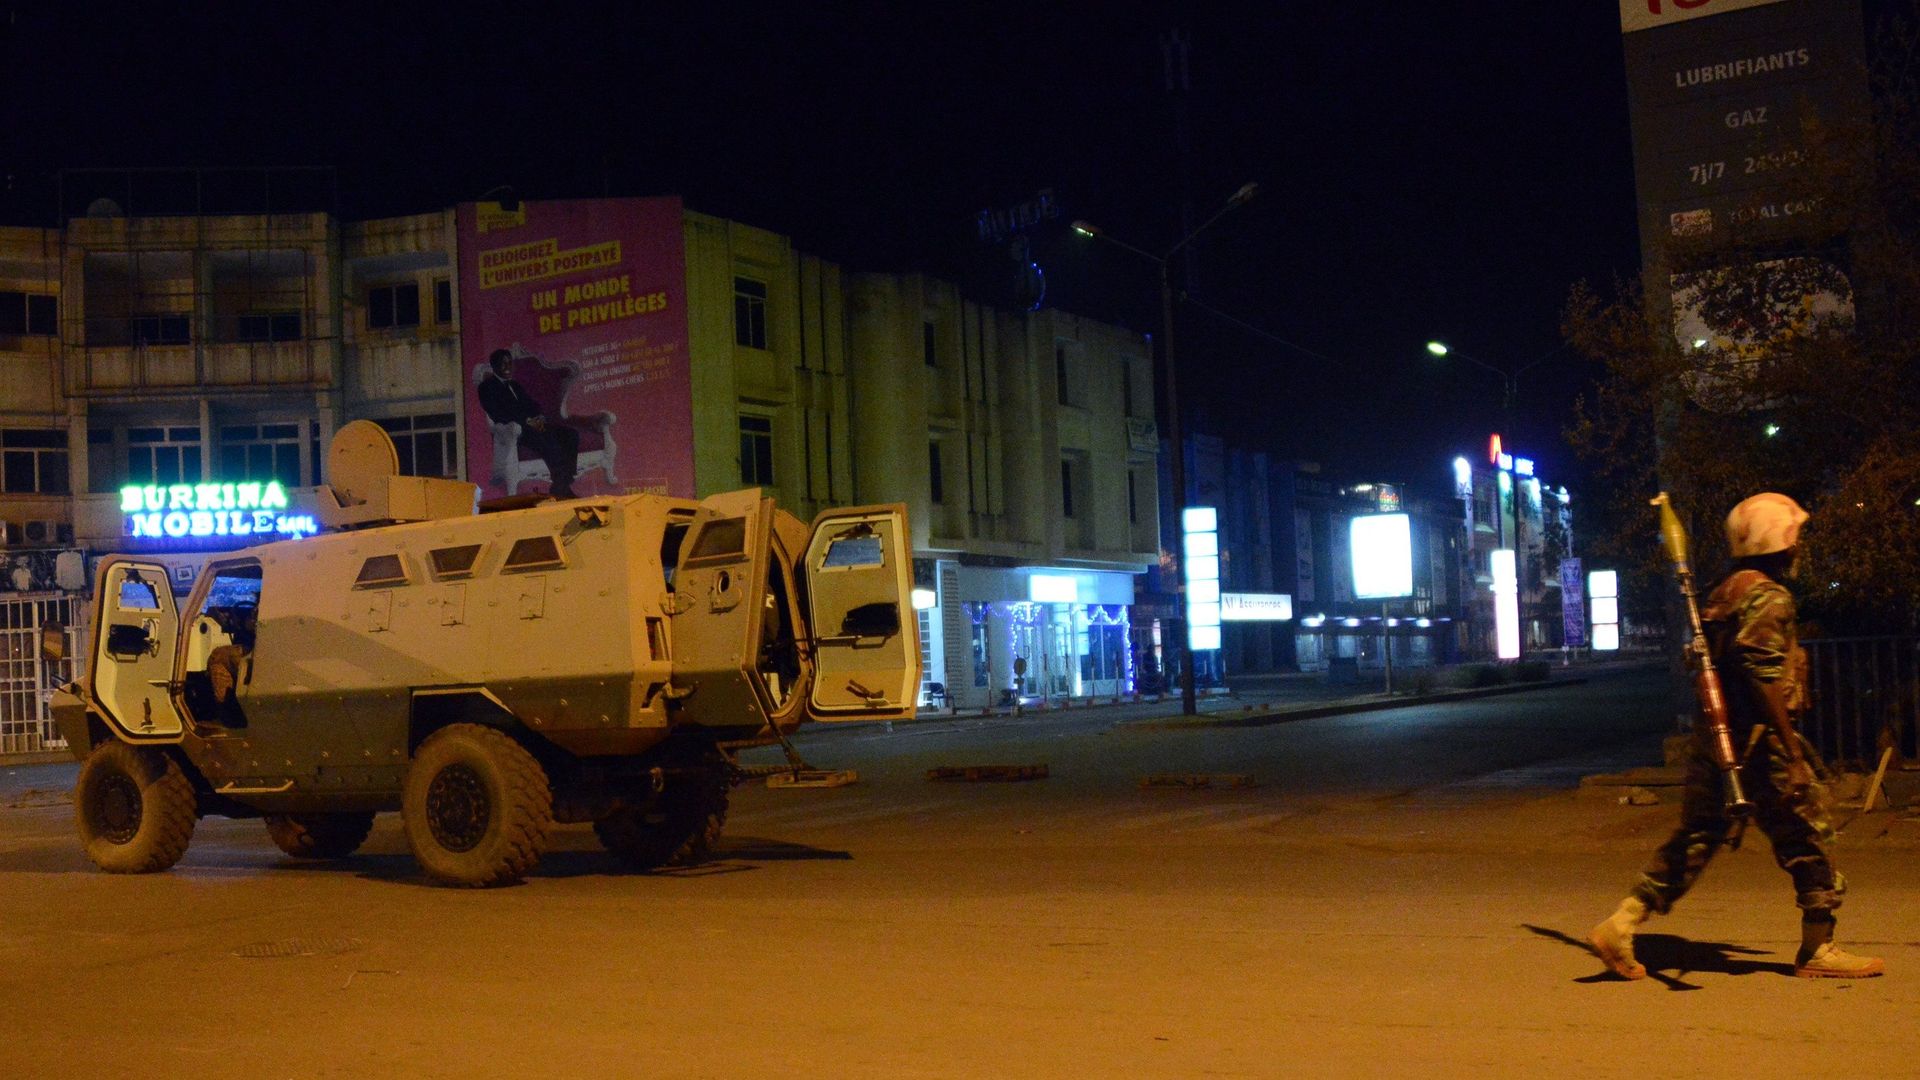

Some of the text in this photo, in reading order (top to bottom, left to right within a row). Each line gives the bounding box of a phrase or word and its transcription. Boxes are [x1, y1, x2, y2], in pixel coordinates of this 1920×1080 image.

[1675, 48, 1810, 88] LUBRIFIANTS
[1724, 106, 1768, 129] GAZ
[1689, 161, 1725, 185] 7j/7
[482, 242, 553, 269] REJOIGNEZ
[483, 244, 617, 285] L'UNIVERS POSTPAYÉ
[531, 275, 630, 311] UN MONDE
[539, 291, 668, 334] DE PRIVILÈGES
[120, 481, 287, 512] BURKINA
[131, 510, 274, 538] MOBILE
